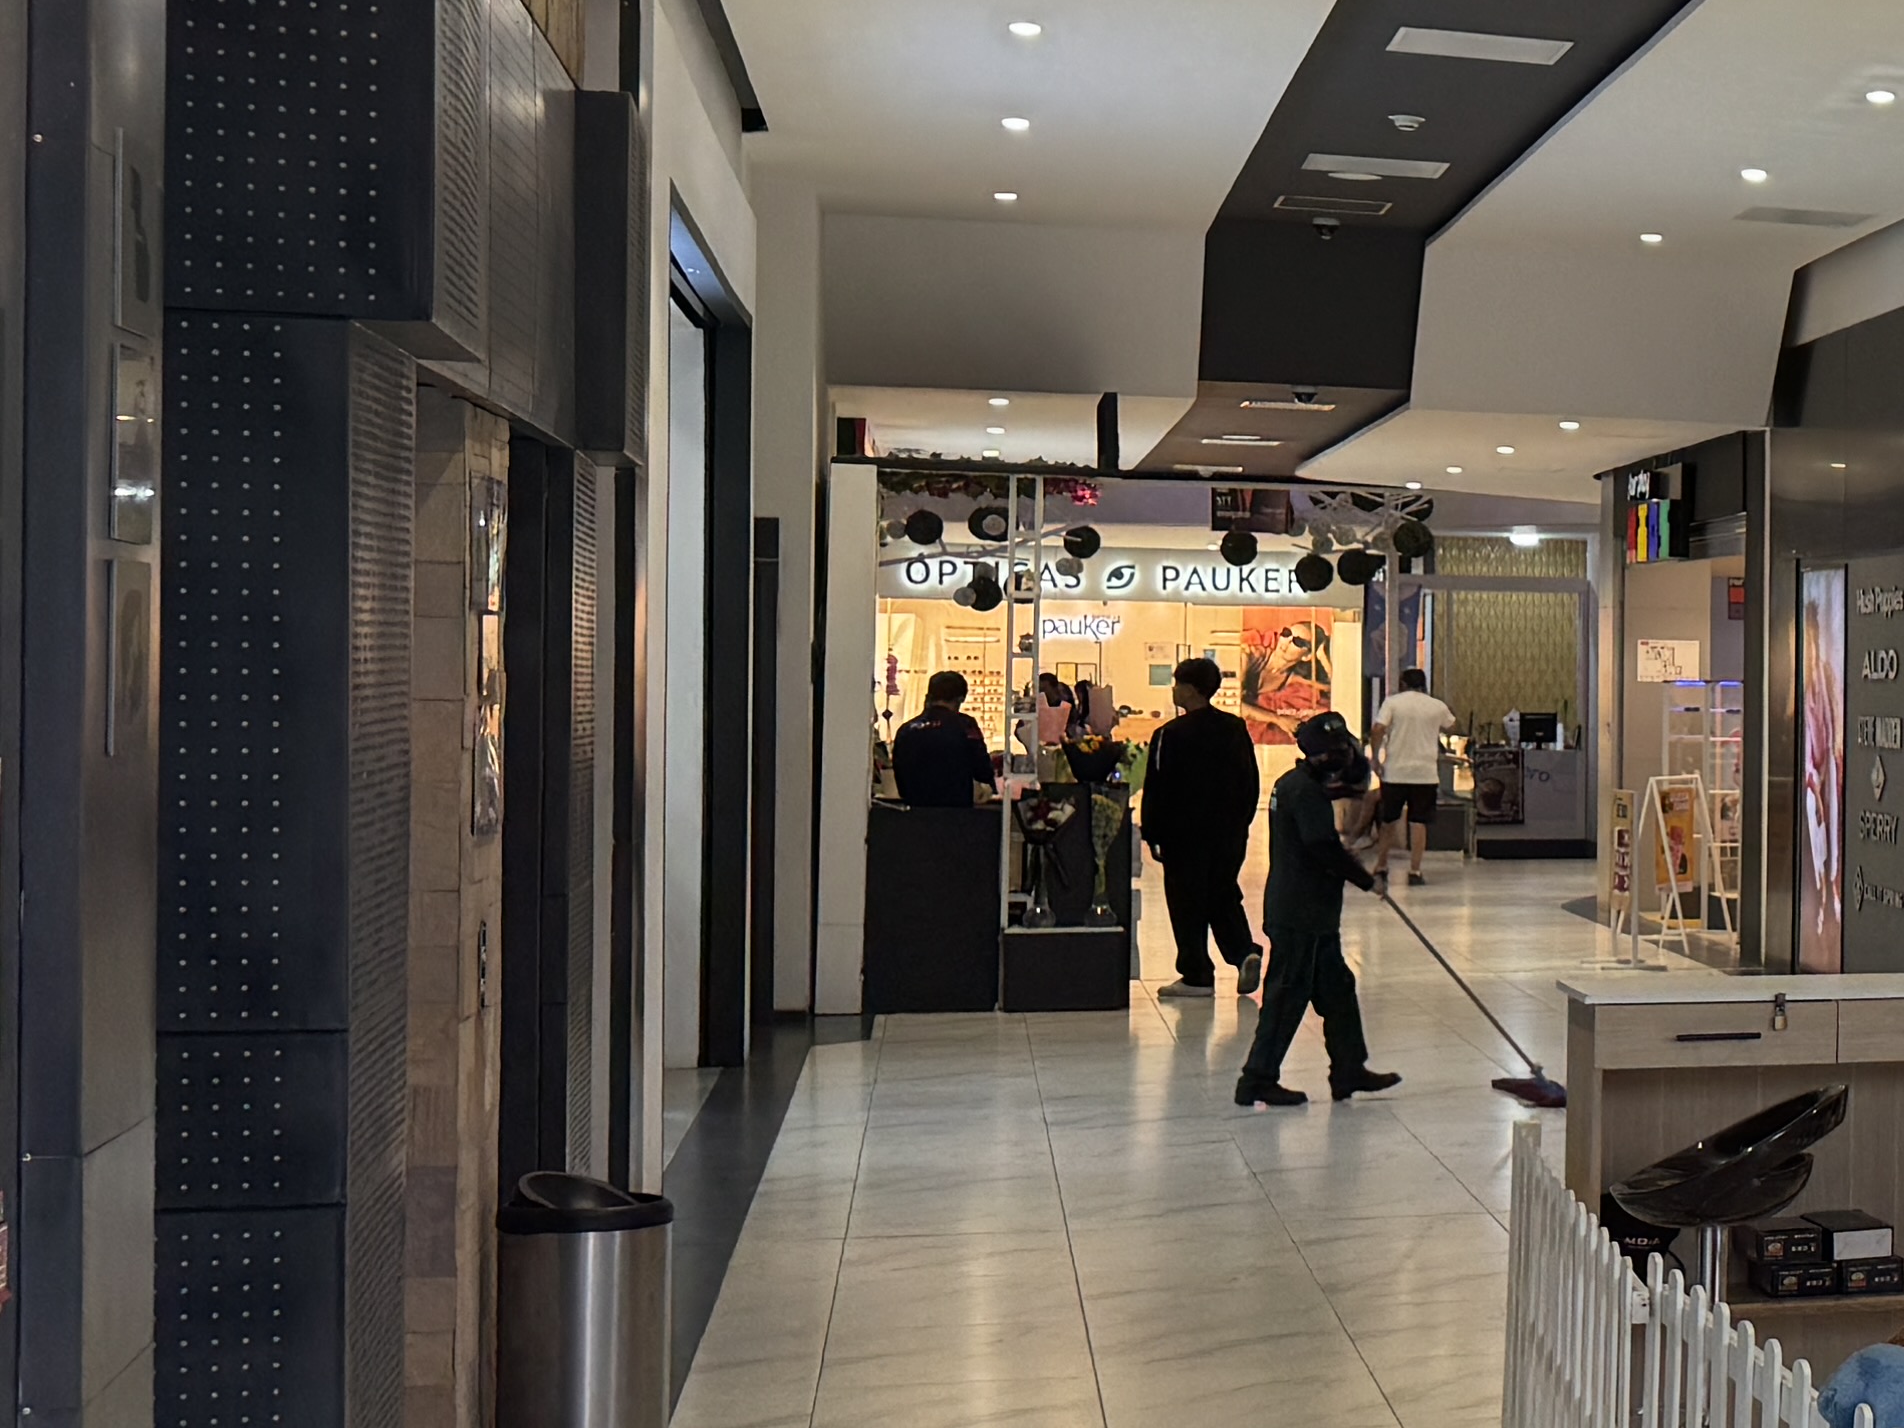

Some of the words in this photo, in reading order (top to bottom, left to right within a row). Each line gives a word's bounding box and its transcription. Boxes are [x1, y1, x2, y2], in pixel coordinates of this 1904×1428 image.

[905, 559, 1081, 589] OPTIAS
[1042, 614, 1121, 641] pauker
[1862, 649, 1899, 680] ALDO
[1859, 810, 1899, 845] SPERRY
